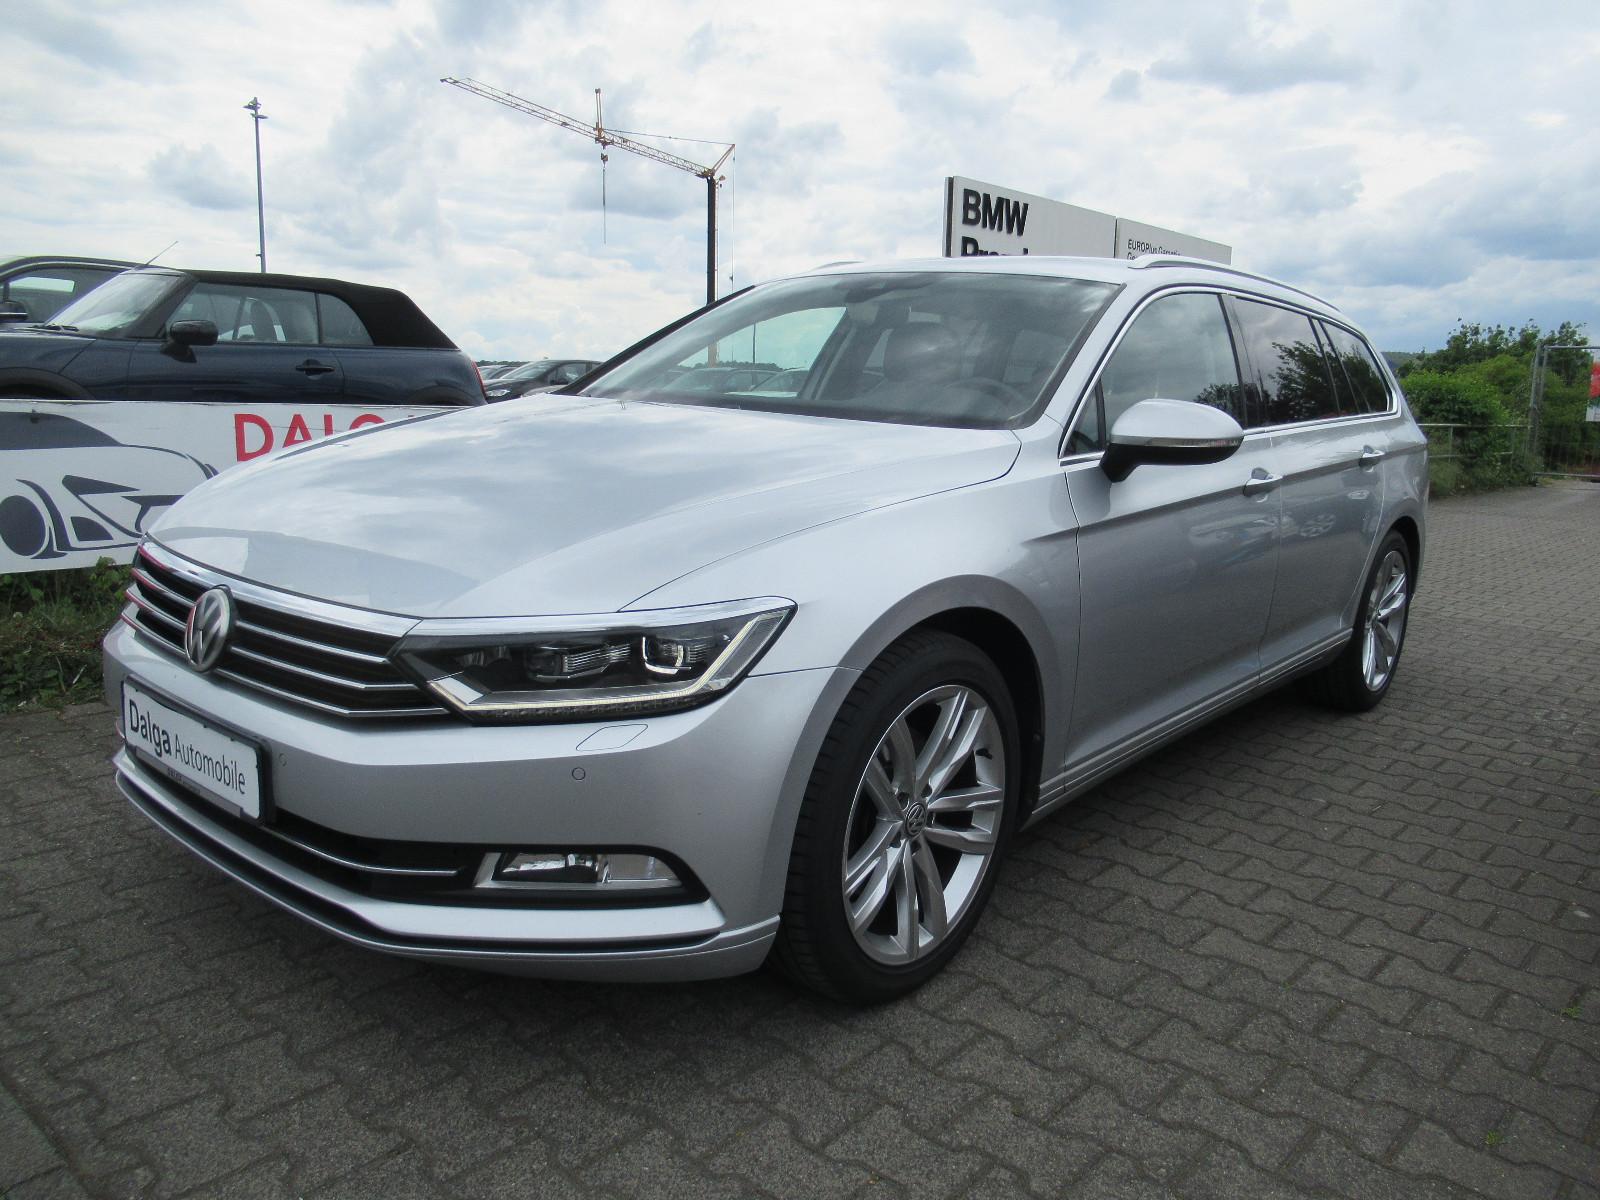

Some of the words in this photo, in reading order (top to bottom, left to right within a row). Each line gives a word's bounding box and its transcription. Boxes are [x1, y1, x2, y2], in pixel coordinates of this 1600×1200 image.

[962, 188, 1029, 237] BMW
[129, 699, 172, 758] Dalga
[175, 734, 246, 795] Automobile
